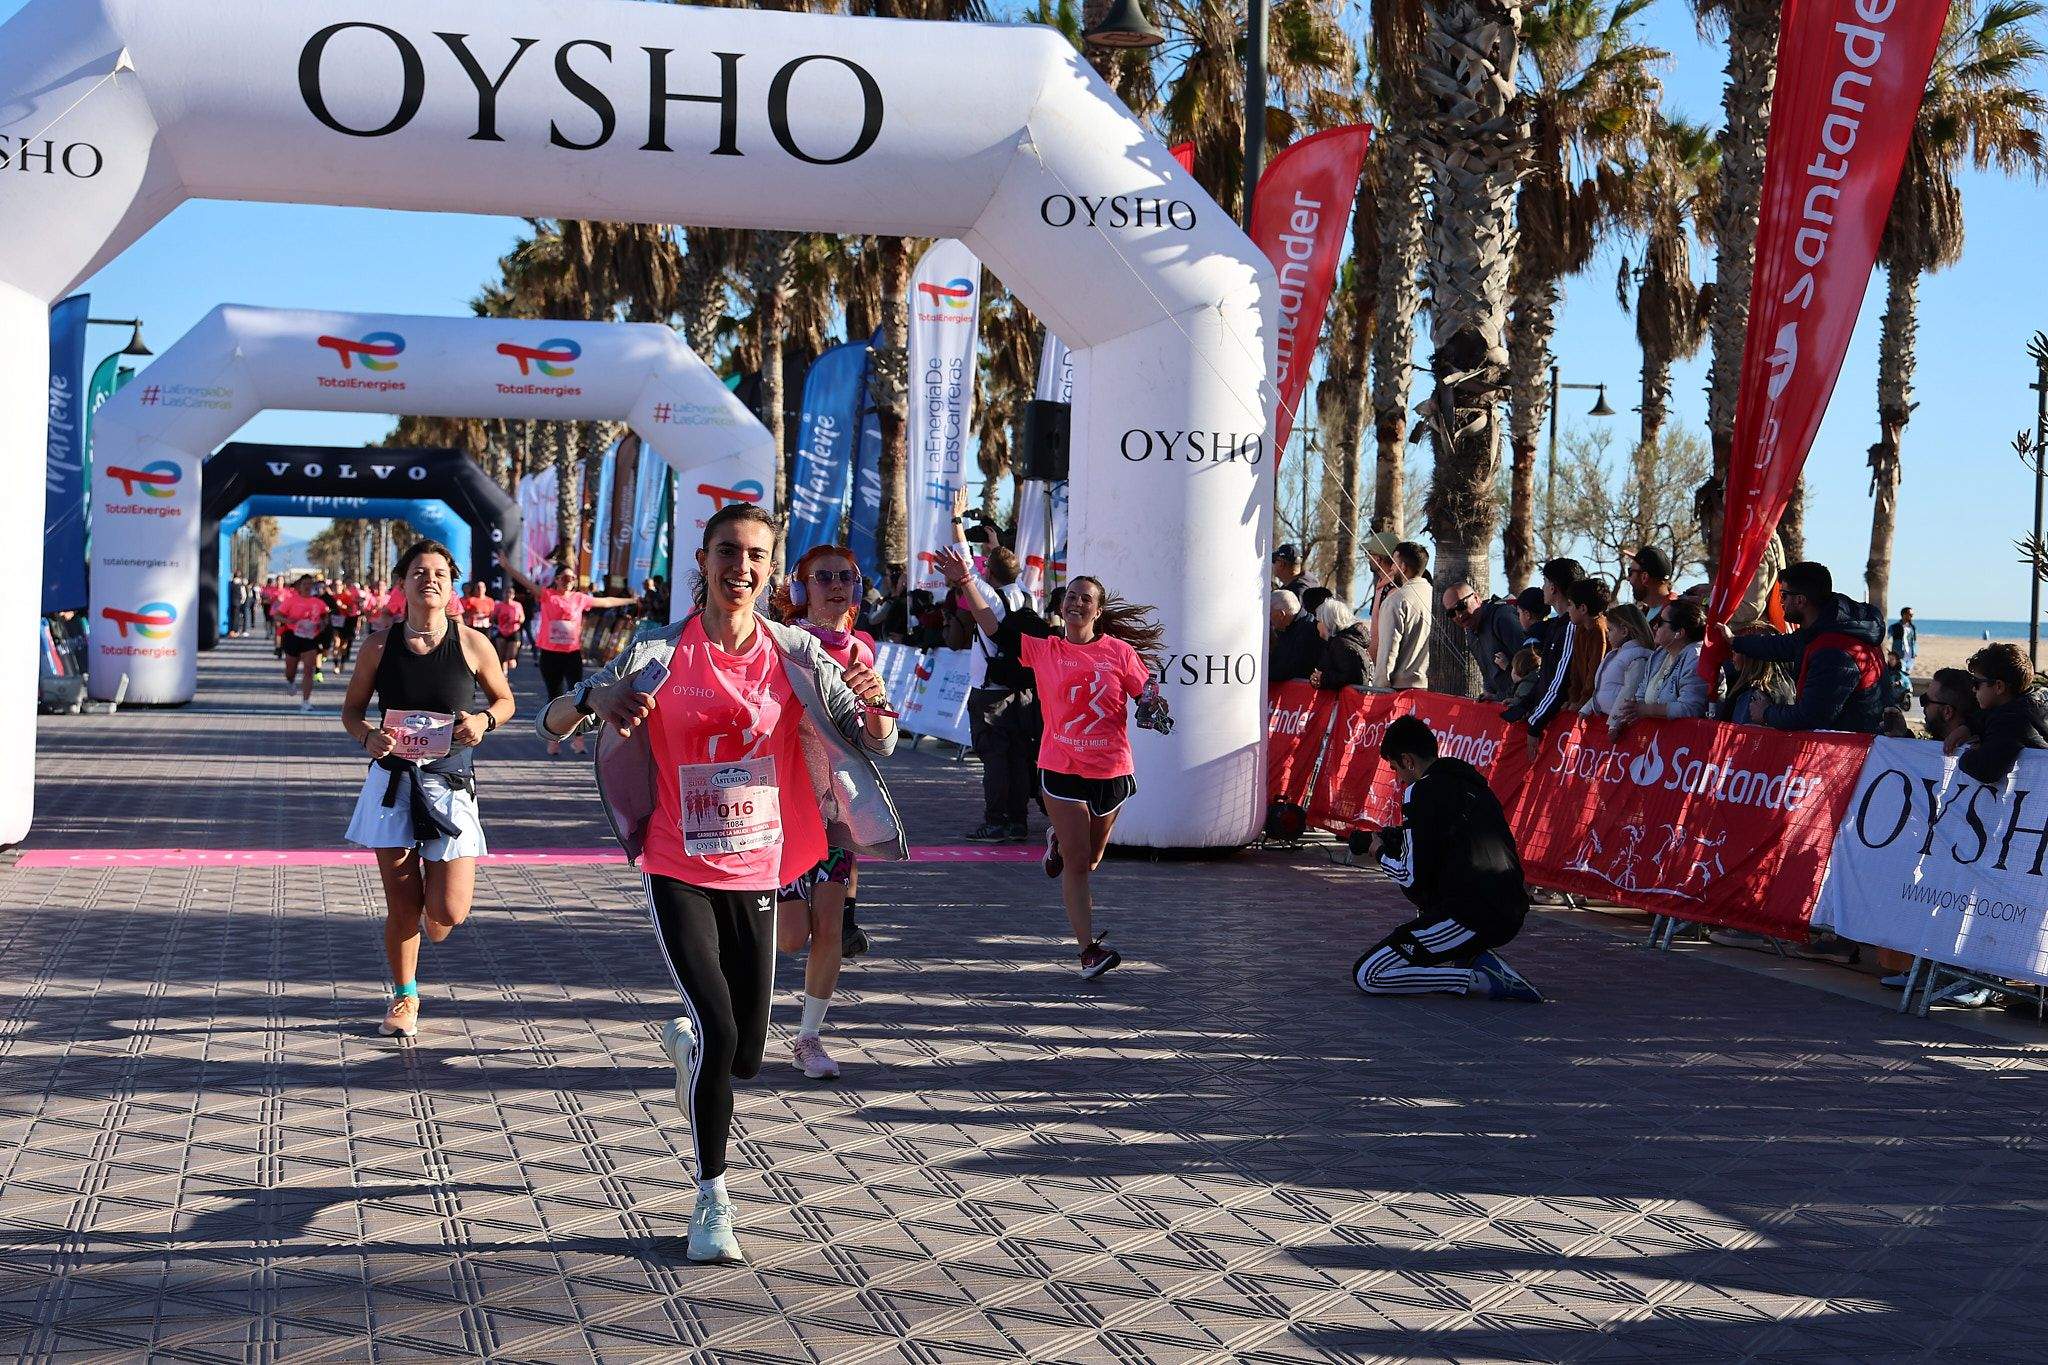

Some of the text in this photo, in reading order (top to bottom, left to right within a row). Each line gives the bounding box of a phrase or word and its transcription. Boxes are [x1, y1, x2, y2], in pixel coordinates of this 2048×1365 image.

[298, 22, 884, 165] OYSHO
[1783, 0, 1896, 310] Santande
[1041, 194, 1196, 231] OYSHO
[918, 313, 974, 324] TotalEnergies
[317, 376, 406, 392] TotalEnergies
[496, 383, 582, 398] TotalEnergies
[943, 357, 963, 474] LasCarreras
[47, 374, 83, 493] Marlene
[1120, 429, 1263, 465] OYSHO
[265, 462, 428, 481] VOLVO
[793, 415, 841, 524] Marlene
[105, 504, 182, 518] TotalEnergies
[101, 645, 178, 659] TotalEnergies
[1156, 653, 1256, 686] YSHO
[672, 685, 715, 698] OYSHO
[403, 736, 429, 746] 016
[1344, 711, 1392, 754] Sport
[1081, 739, 1089, 747] LA
[714, 775, 750, 785] ASTURIANA
[1550, 731, 1822, 812] Sports Santander
[717, 800, 754, 818] 016
[726, 820, 744, 828] 1084
[1857, 769, 2048, 877] OYSH
[697, 841, 728, 850] OYSHO
[1902, 882, 2028, 923] WWW.OYSHO.COM
